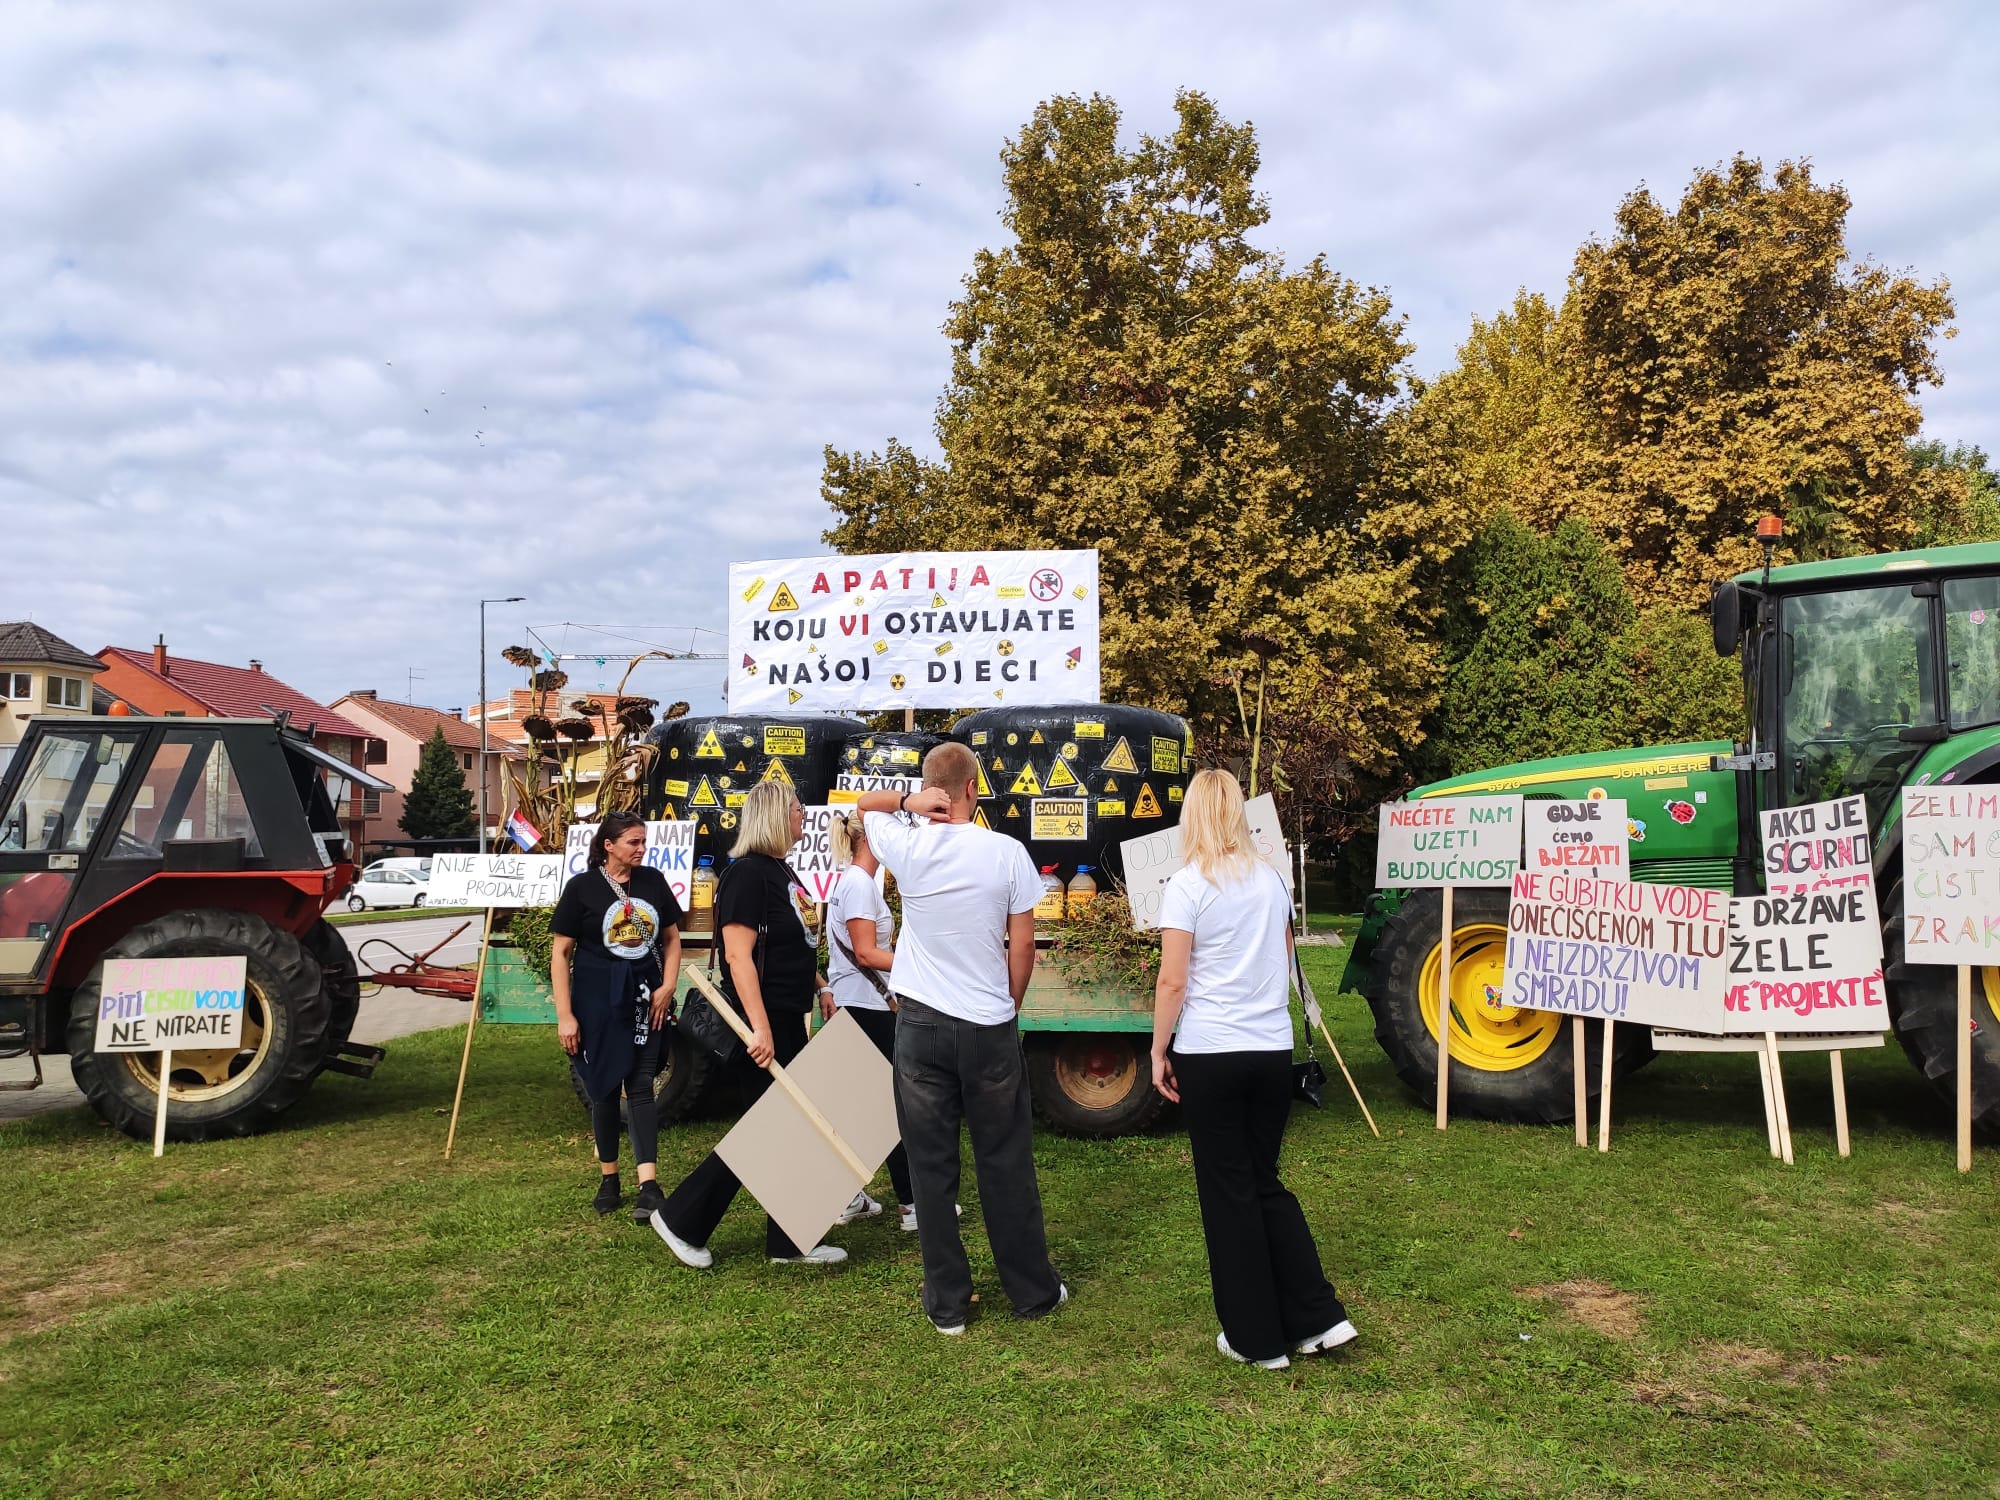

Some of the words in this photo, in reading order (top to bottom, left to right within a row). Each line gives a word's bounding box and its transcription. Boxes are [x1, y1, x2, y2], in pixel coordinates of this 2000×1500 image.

[811, 565, 990, 593] APATIJA
[753, 618, 826, 641] KOJU
[839, 614, 869, 636] VI
[884, 608, 1075, 634] OSTAVLJATE
[769, 654, 869, 685] NAŠOJ
[927, 659, 1037, 684] DJECI
[767, 728, 802, 737] CAUTION
[1613, 766, 1653, 779] JOHN
[1656, 761, 1709, 775] DEERE
[1036, 803, 1082, 815] CAUTION
[1389, 802, 1456, 827] NEĆETE
[1469, 806, 1513, 824] NAM
[1547, 803, 1601, 822] GDJE
[1769, 808, 1816, 839] AKO
[1825, 799, 1863, 831] JE
[1906, 792, 1998, 819] ŽELIM
[654, 824, 697, 846] NAM
[1413, 830, 1478, 851] UZETI
[1553, 826, 1593, 843] ćemo
[1387, 855, 1518, 880] BUDUĆNOST
[1538, 841, 1620, 867] BJEŽATI
[1766, 833, 1870, 874] SIGURNO
[437, 856, 476, 874] NIJE
[489, 857, 526, 877] VAŠE
[539, 864, 558, 881] DA
[1914, 868, 2000, 898] ČIST
[1513, 872, 1543, 900] NE
[1549, 876, 1643, 912] GUBITKU
[1652, 885, 1726, 926] VODE,
[1753, 890, 1866, 926] DRŽAVE
[1667, 919, 1725, 958] TLU
[1507, 937, 1516, 969] I
[1525, 939, 1700, 990] NEIZDRŽIVOM
[1729, 933, 1833, 973] ŽELE
[102, 990, 142, 1020] PITI
[195, 989, 245, 1009] VODU
[1512, 972, 1630, 1017] SMRADU!
[111, 1020, 146, 1043] NE
[156, 1014, 231, 1038] NITRATE
